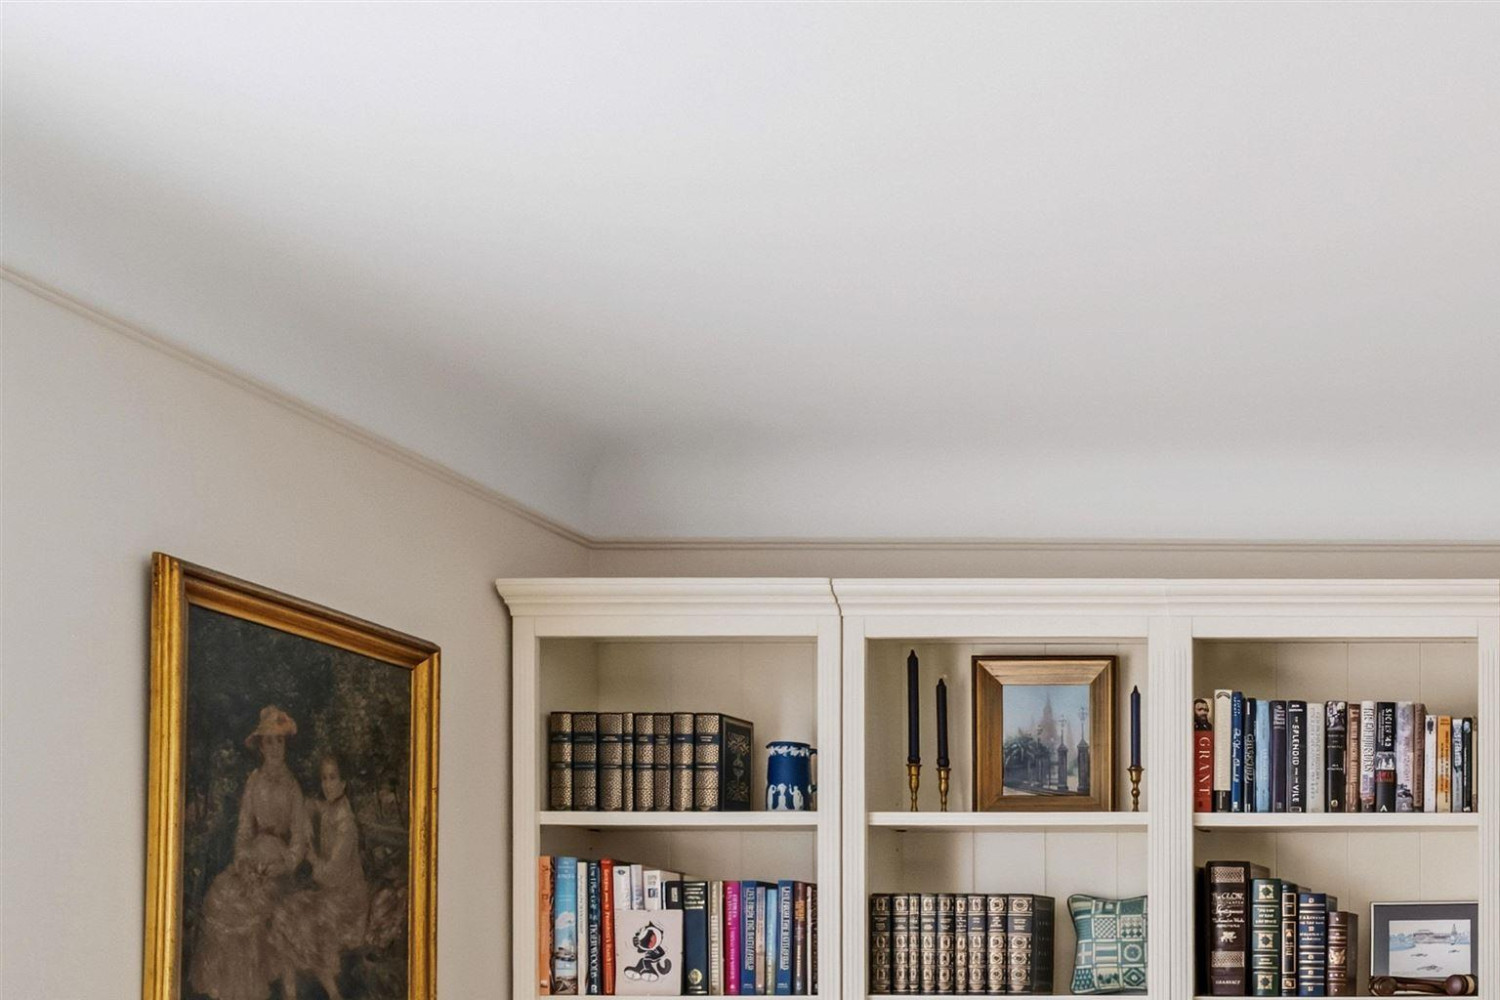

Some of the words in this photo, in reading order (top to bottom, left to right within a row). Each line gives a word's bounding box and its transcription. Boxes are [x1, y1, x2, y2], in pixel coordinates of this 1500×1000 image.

[1198, 736, 1212, 796] GRANT
[1292, 724, 1300, 766] SPLENDID
[1292, 784, 1300, 804] VILE
